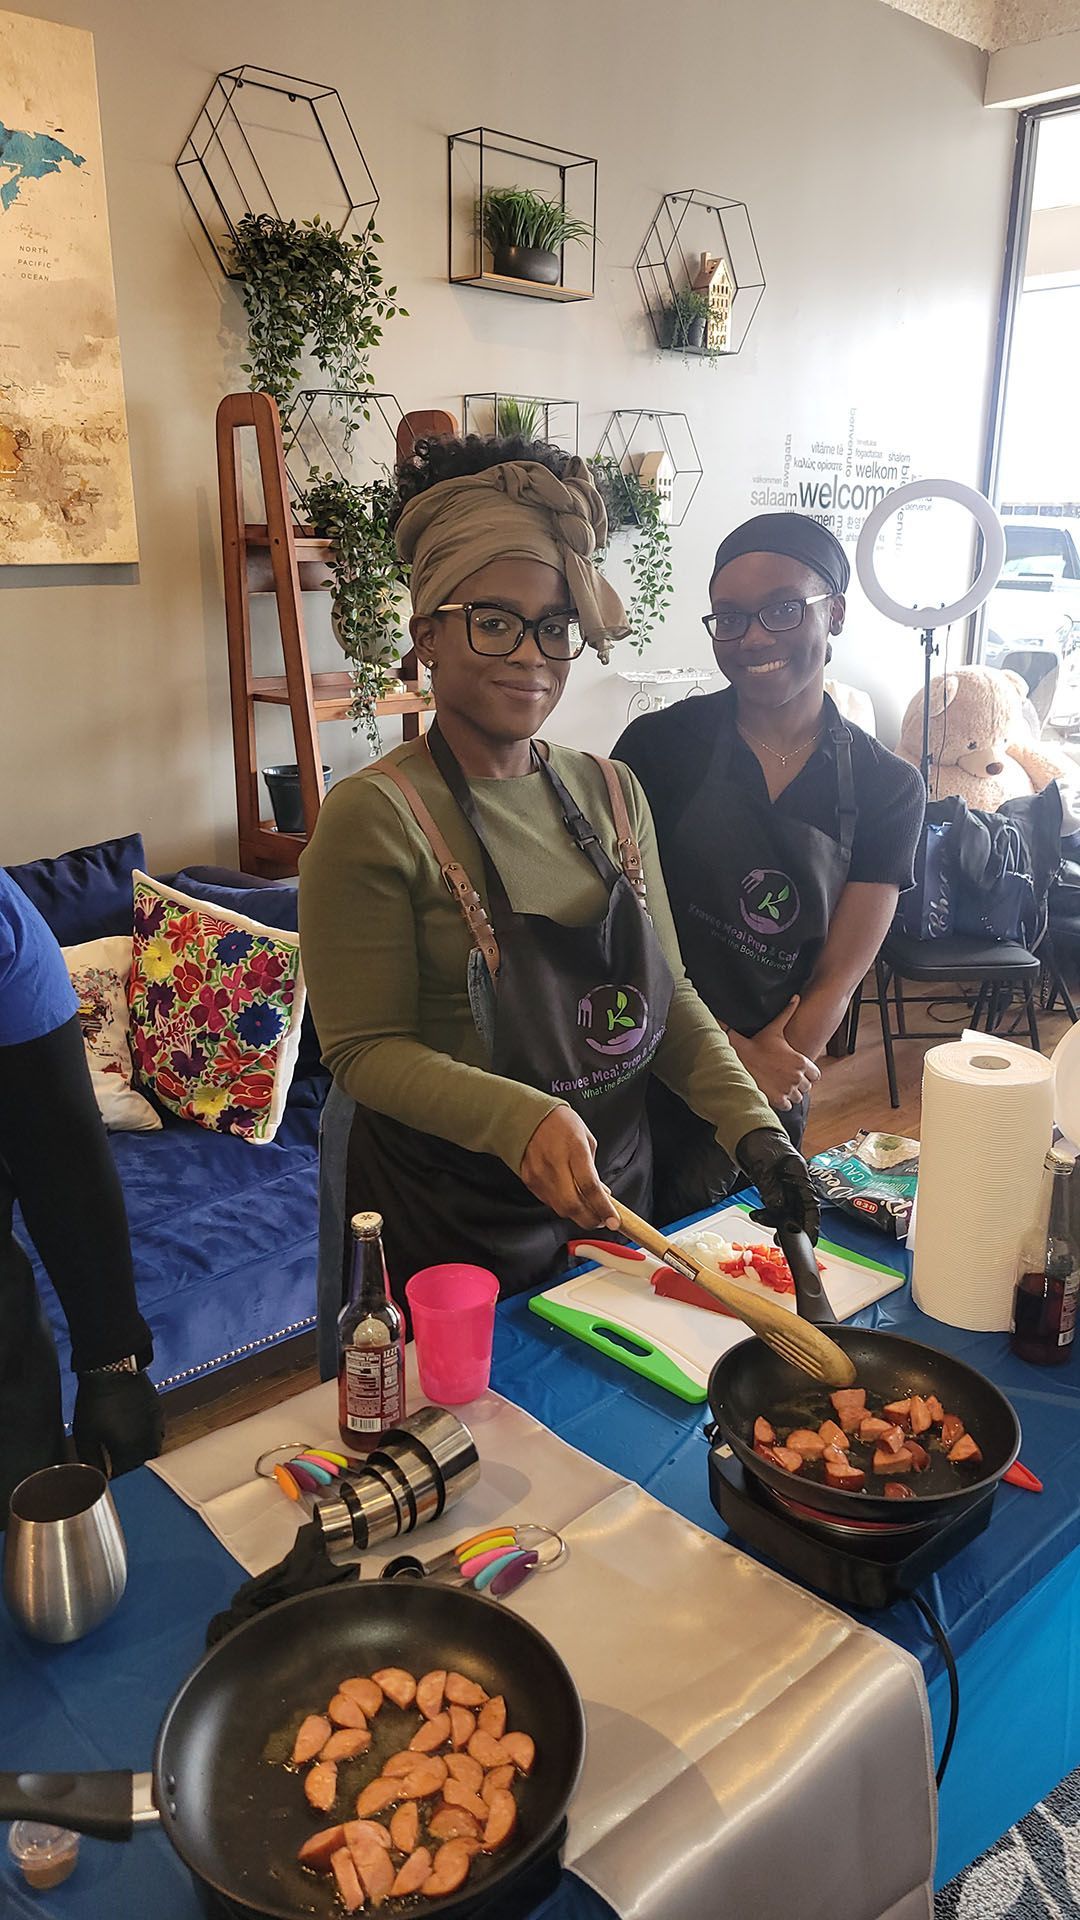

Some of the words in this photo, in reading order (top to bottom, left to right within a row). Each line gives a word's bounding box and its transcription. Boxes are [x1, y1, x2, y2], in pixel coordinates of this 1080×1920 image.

[19, 245, 48, 254] NORTH
[17, 258, 52, 268] PACIFIC
[20, 272, 49, 282] OCEAN
[855, 462, 898, 480] welkom
[750, 487, 797, 507] salaam
[747, 934, 768, 953] Prep
[551, 1078, 590, 1093] Kravee
[592, 1064, 620, 1082] Meal
[581, 1086, 604, 1100] What
[604, 1080, 616, 1092] the
